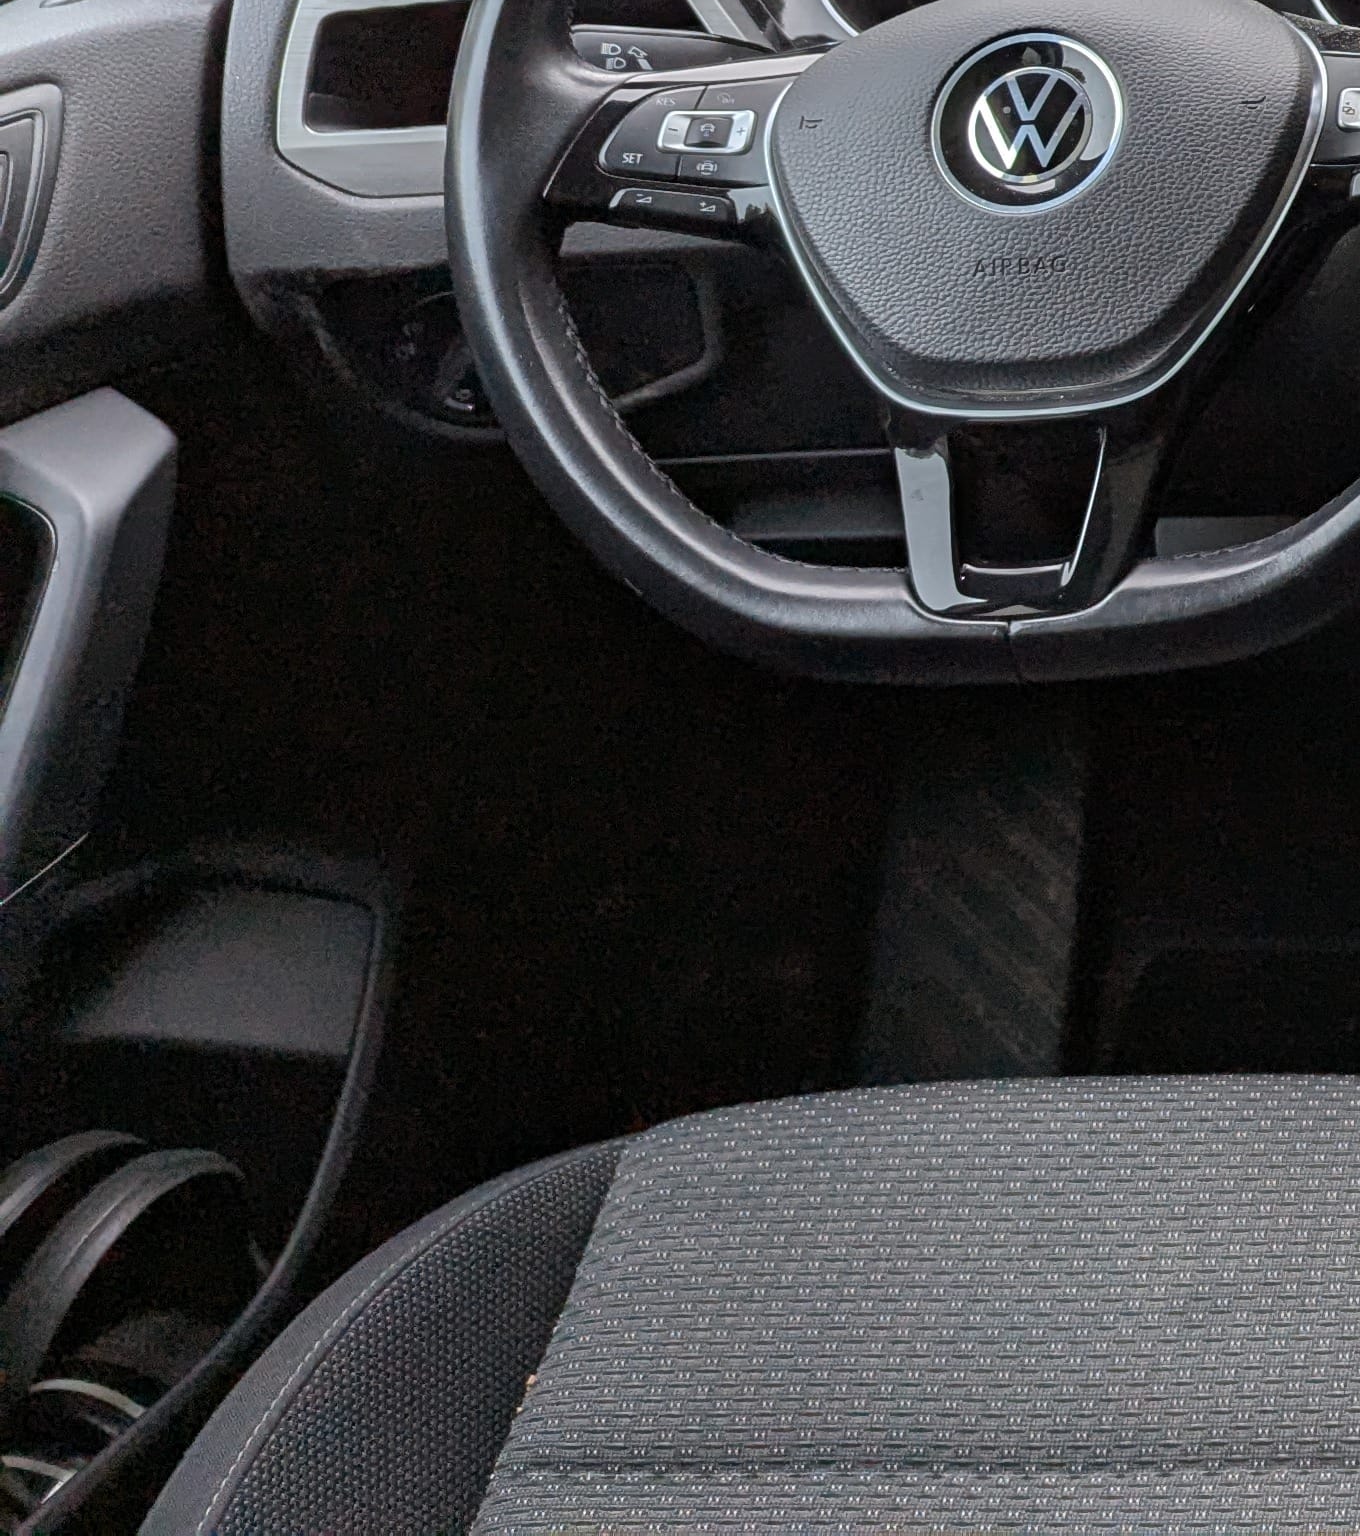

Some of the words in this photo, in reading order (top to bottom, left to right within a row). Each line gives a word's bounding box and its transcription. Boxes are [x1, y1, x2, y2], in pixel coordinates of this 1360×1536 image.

[655, 96, 676, 106] RES
[621, 152, 643, 165] SET
[972, 255, 1067, 278] AIRBAG
